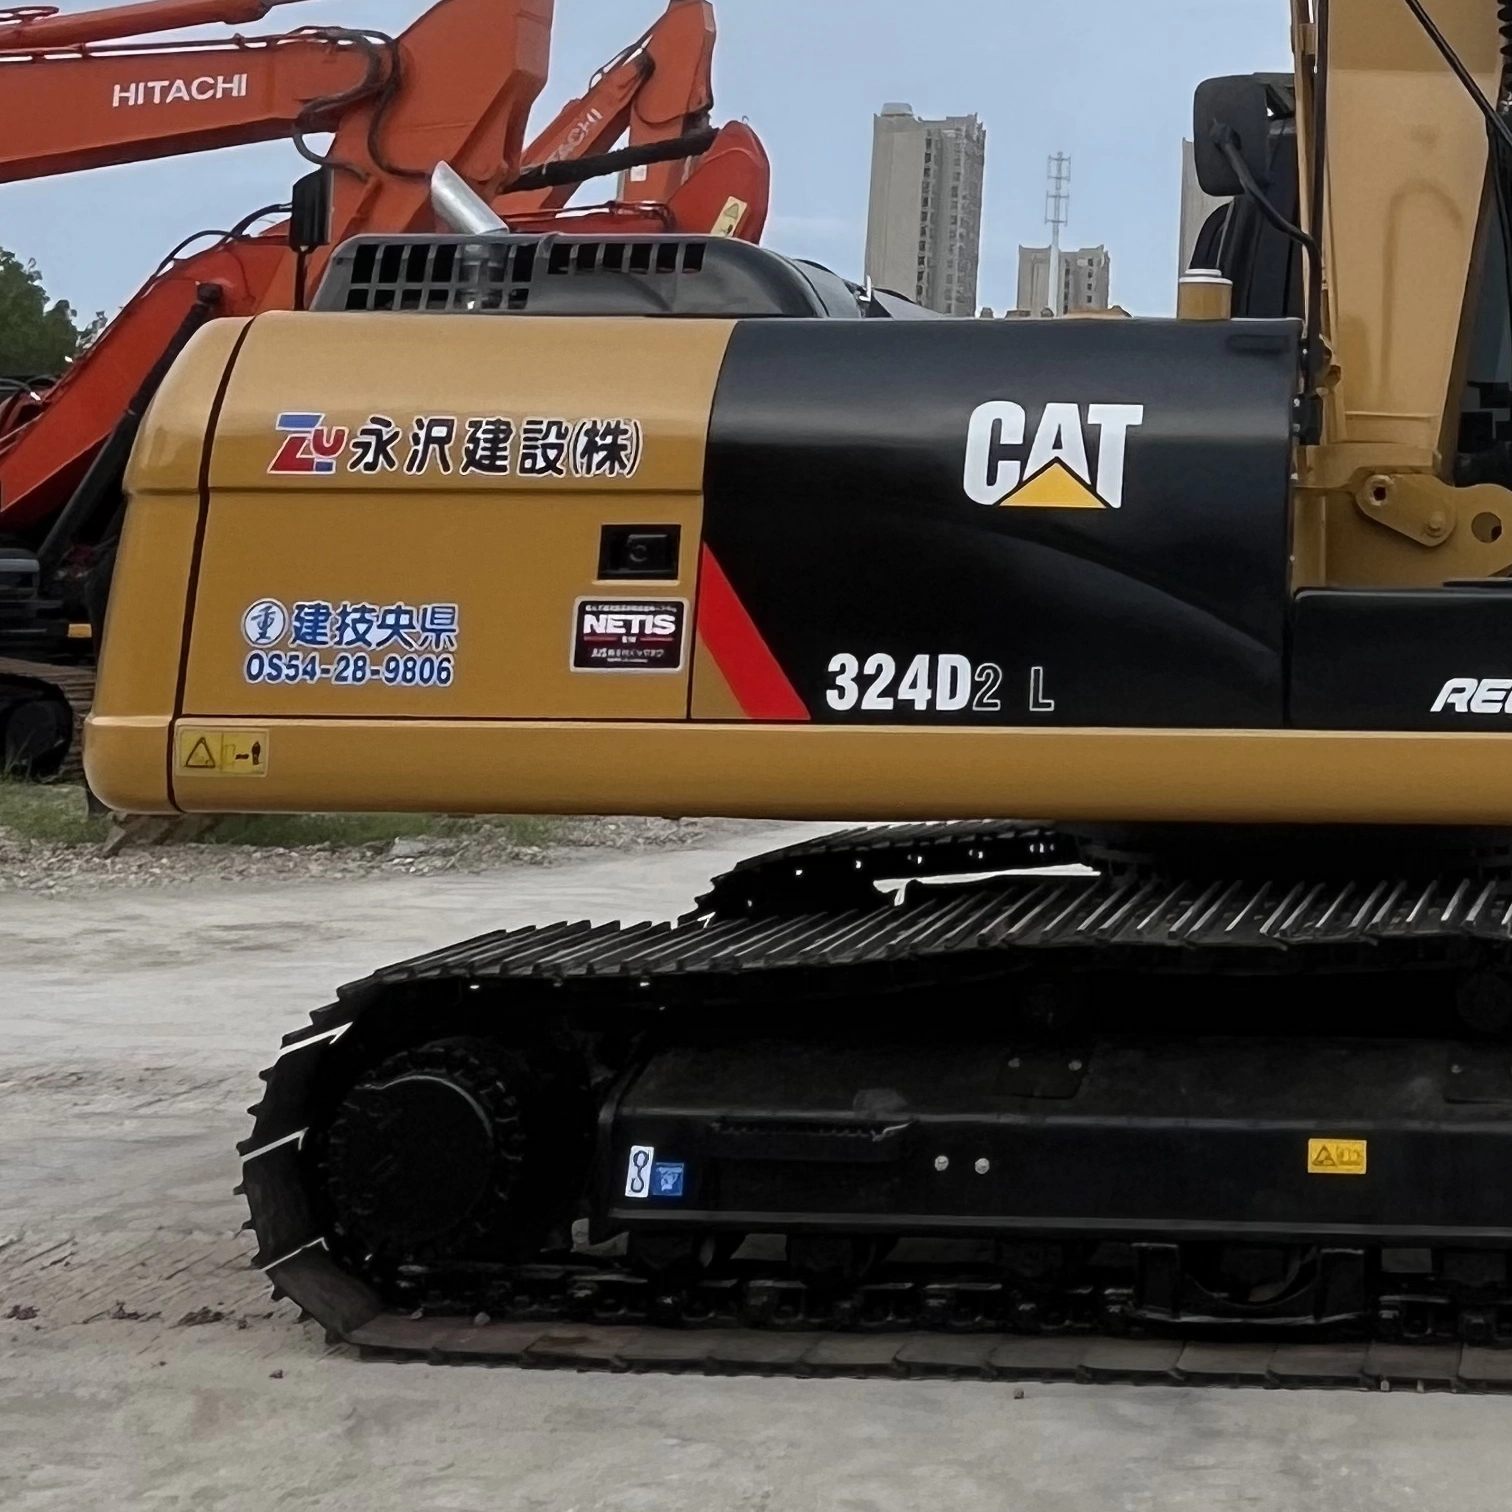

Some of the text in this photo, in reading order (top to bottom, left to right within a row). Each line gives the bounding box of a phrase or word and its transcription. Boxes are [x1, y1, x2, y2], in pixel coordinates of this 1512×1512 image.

[112, 73, 248, 107] HITACHI
[963, 400, 1144, 508] CAT
[583, 614, 676, 635] NETIS
[1029, 666, 1054, 712] L
